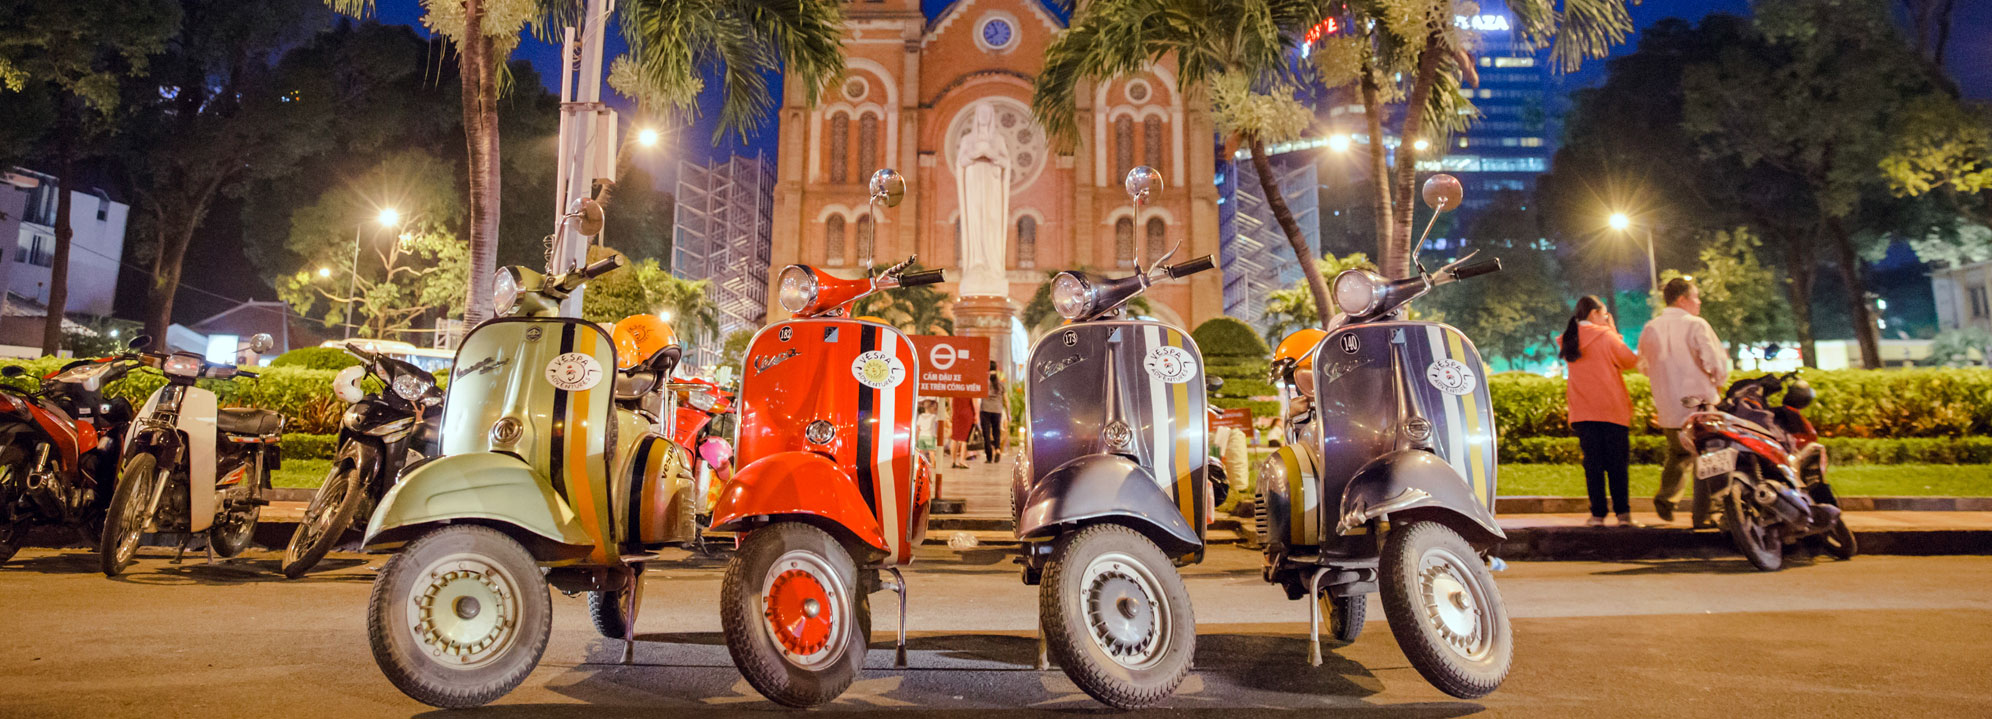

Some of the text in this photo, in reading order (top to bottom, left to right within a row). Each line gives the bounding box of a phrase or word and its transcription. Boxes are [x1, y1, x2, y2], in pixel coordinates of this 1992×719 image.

[1343, 335, 1358, 351] 140
[859, 352, 891, 364] VESPA
[1150, 348, 1189, 382] VESPA ADVENTURES
[550, 353, 591, 389] VESPA ADVENTURES
[953, 374, 962, 382] XE
[1433, 360, 1468, 394] VESPA ADVENTURES
[858, 373, 895, 386] ADVENTURES
[921, 382, 929, 391] XE
